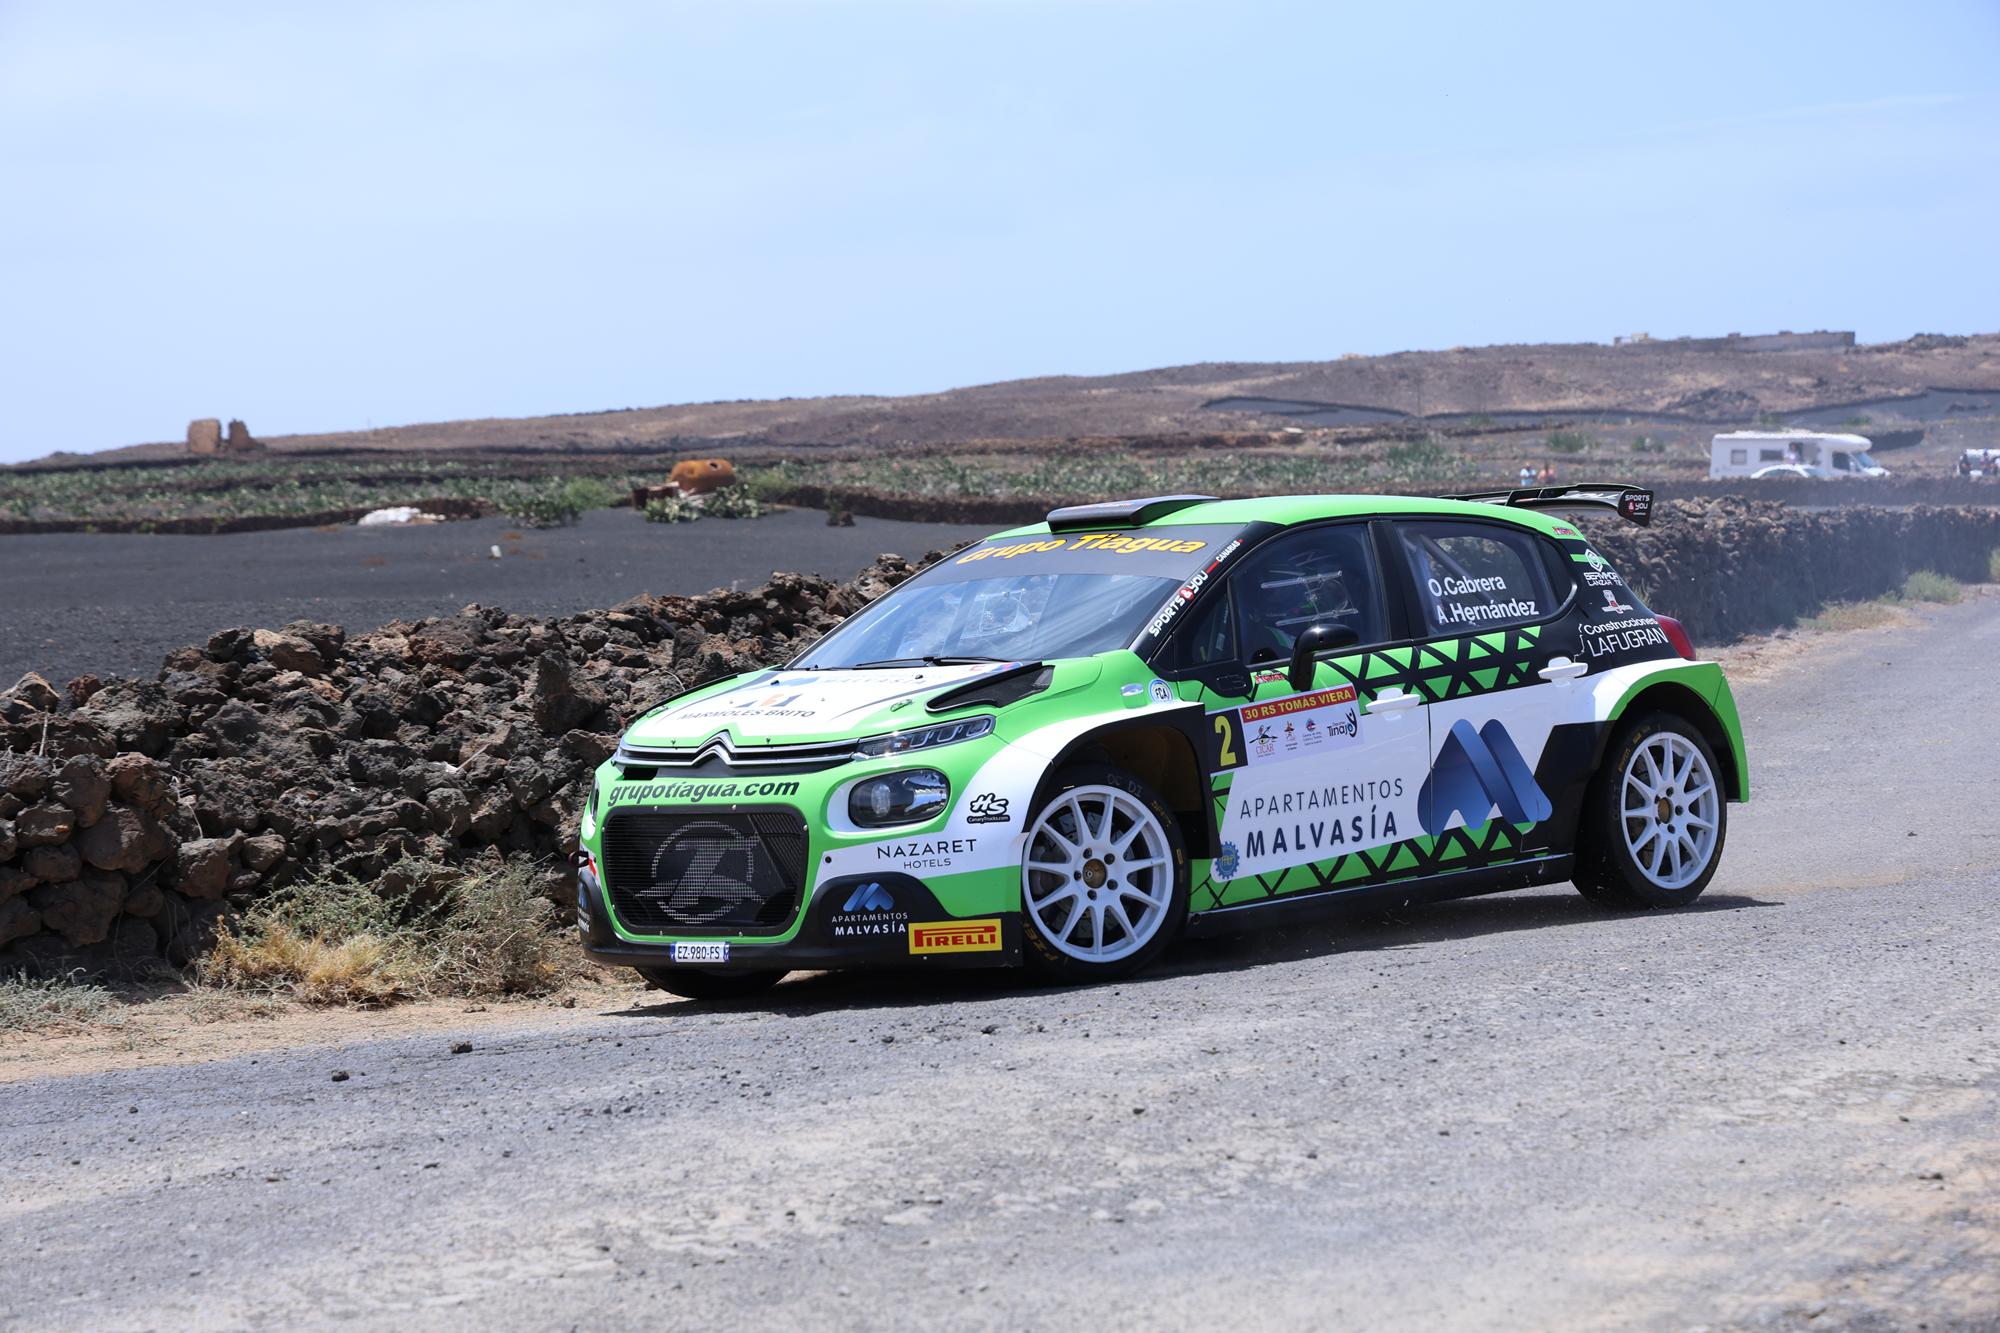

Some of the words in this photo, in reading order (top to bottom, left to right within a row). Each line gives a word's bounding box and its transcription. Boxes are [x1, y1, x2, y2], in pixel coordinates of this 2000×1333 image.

[1625, 494, 1650, 502] SPORTS
[956, 538, 1068, 564] Grupo
[1216, 540, 1240, 562] CANARIAS
[1428, 575, 1507, 597] O.Cabrera
[1436, 598, 1540, 624] A.Hernández
[1583, 618, 1659, 635] Construcciones
[1587, 627, 1669, 657] LAFUGRAN
[1155, 687, 1168, 700] FCA
[763, 709, 815, 718] BRITO
[1245, 709, 1258, 720] 30
[1261, 705, 1276, 717] RS
[1318, 690, 1352, 704] VIERA
[1214, 715, 1237, 767] 2
[1239, 777, 1404, 820] APARTAMENTOS
[1246, 805, 1398, 859] MALVASÍA
[877, 839, 977, 860] NAZARET
[903, 858, 952, 870] HOTELS
[831, 912, 909, 924] APARTAMENTOS
[835, 923, 907, 936] MALVASÍA
[914, 925, 997, 948] PIRELLI
[677, 945, 720, 960] EZ-980-FS
